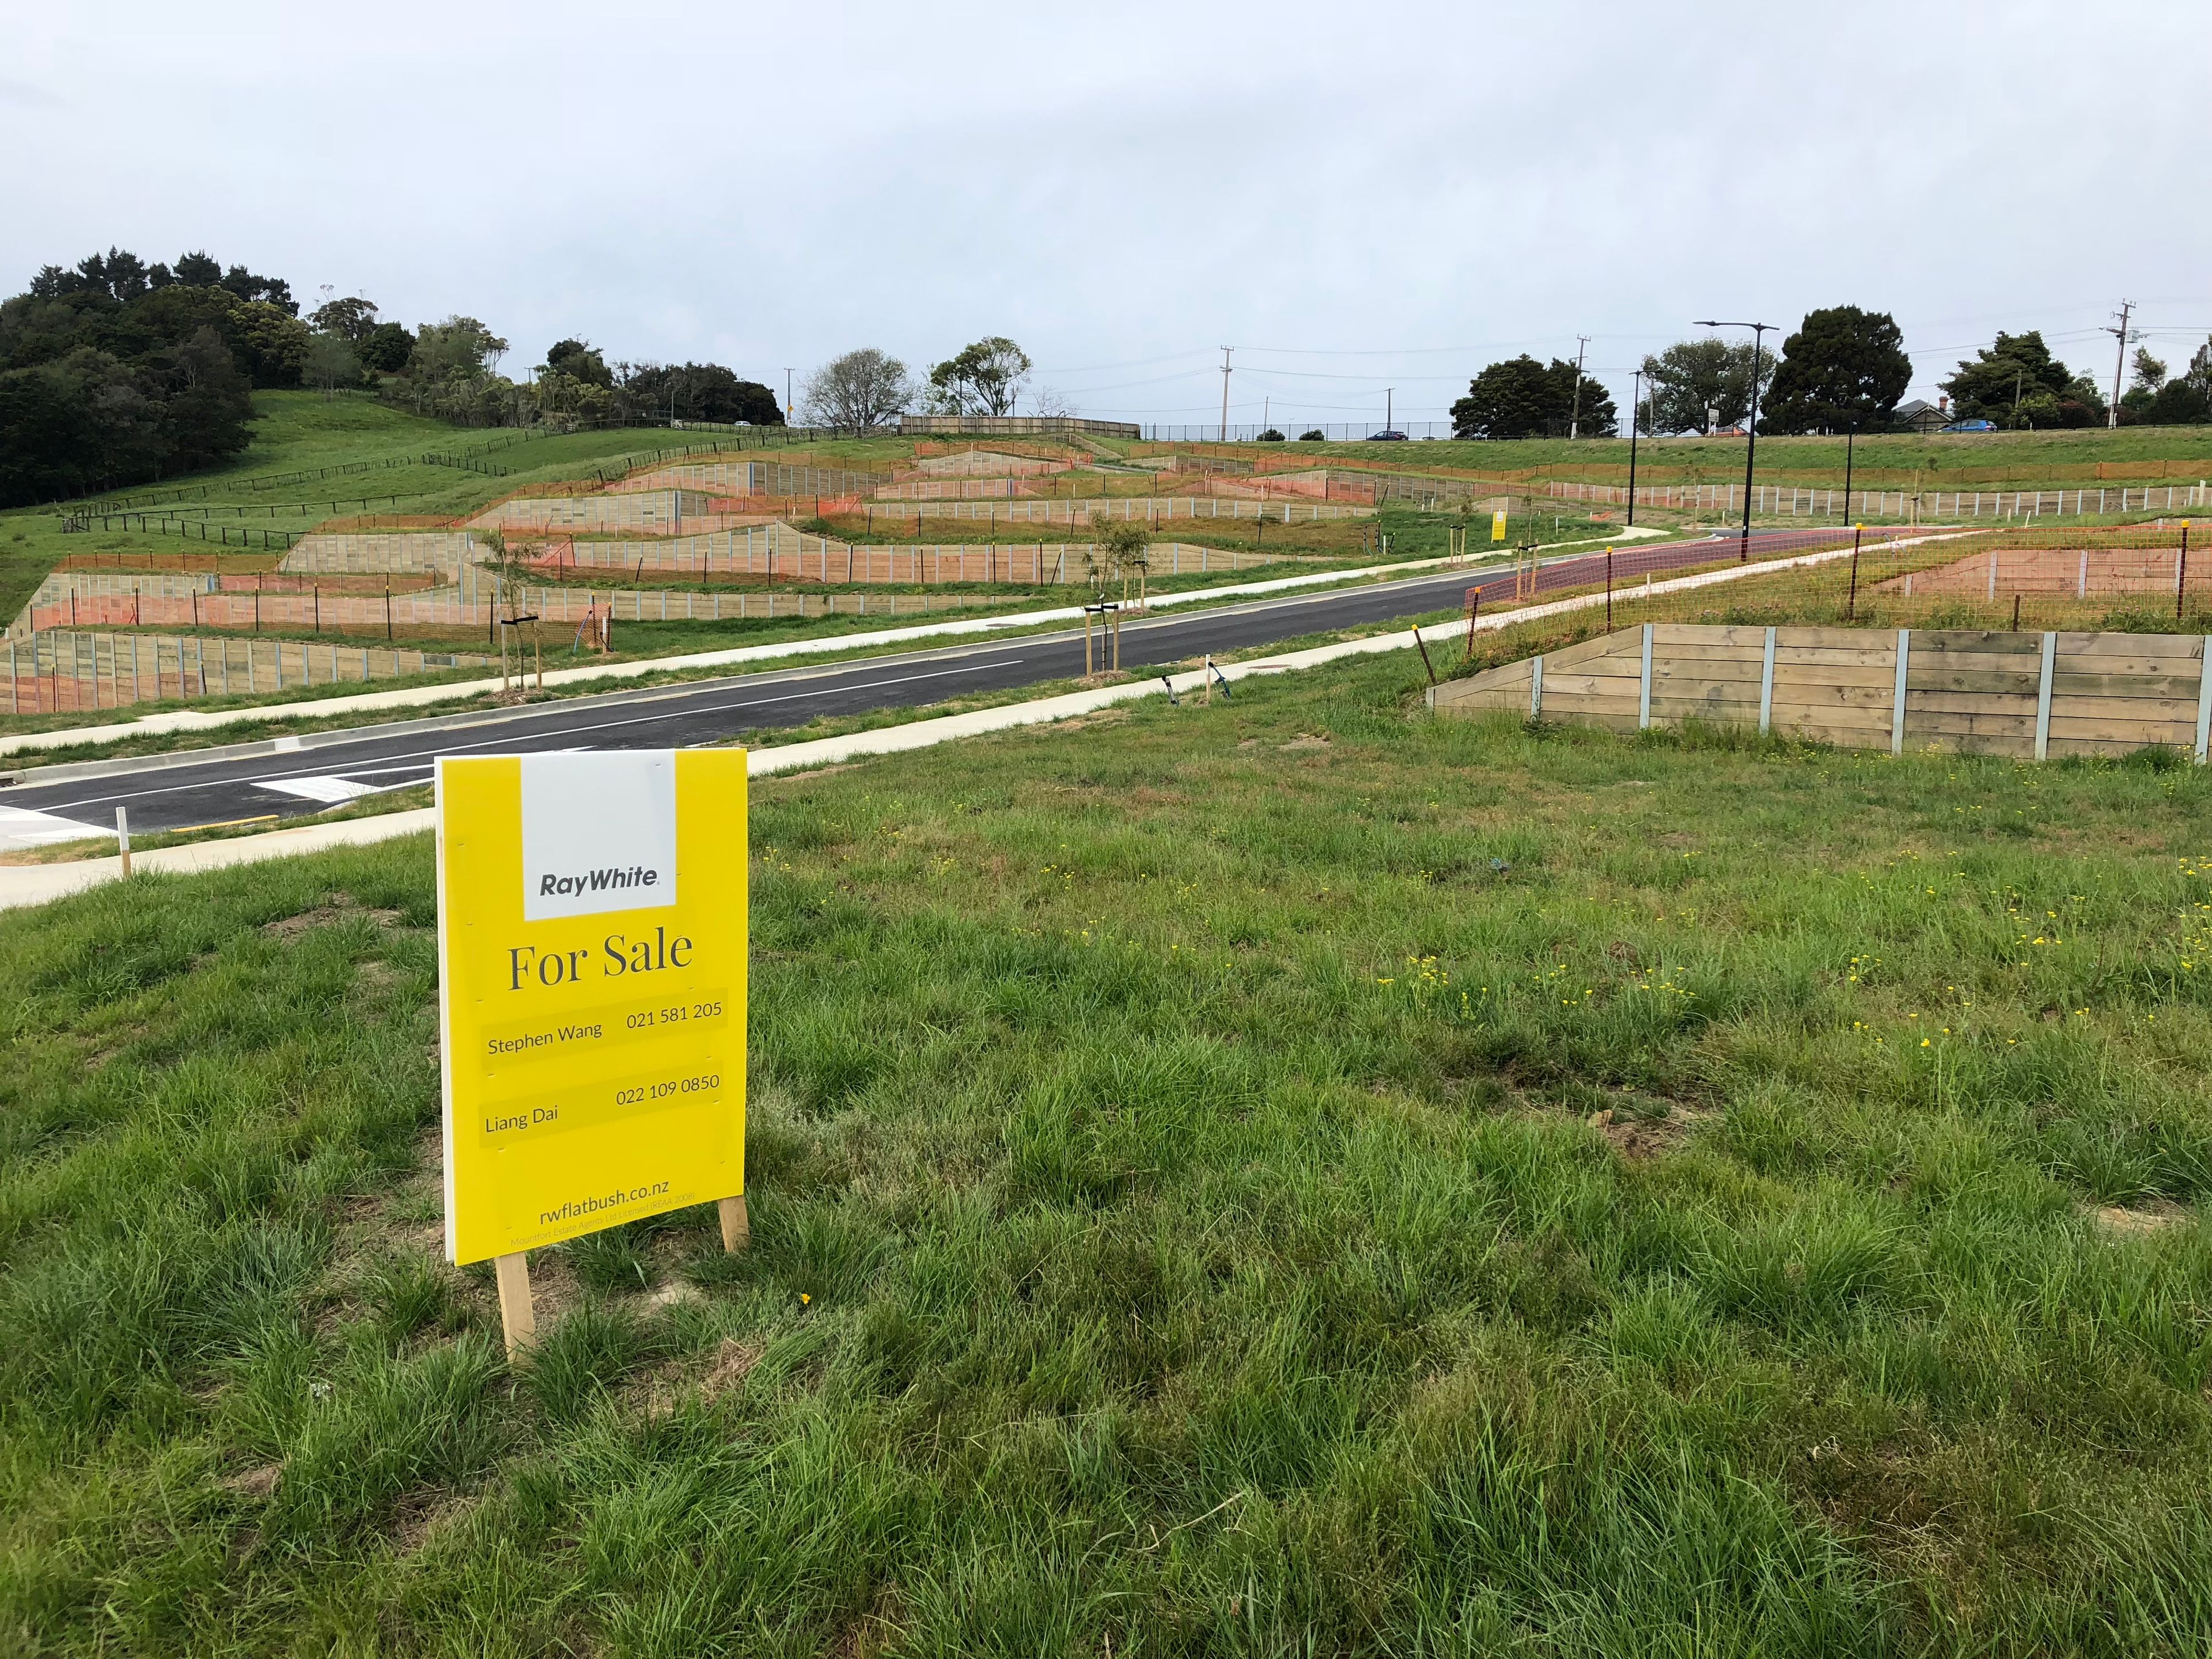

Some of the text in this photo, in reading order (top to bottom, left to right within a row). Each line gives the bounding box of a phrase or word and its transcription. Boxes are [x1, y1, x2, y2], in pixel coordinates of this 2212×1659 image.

[507, 926, 692, 990] For Sale
[488, 1002, 721, 1054] Stephen Wang 021 581 205
[486, 1075, 719, 1133] Liang Dai 022 109 0850
[510, 1231, 551, 1246] Mountfort
[554, 1225, 577, 1236] Estate
[578, 1218, 603, 1229] Agents
[605, 1213, 616, 1222] Ltd
[619, 1203, 649, 1218] Licensed
[674, 1192, 695, 1204] 2008)
[540, 1181, 669, 1225] rwflatbush.co.nz
